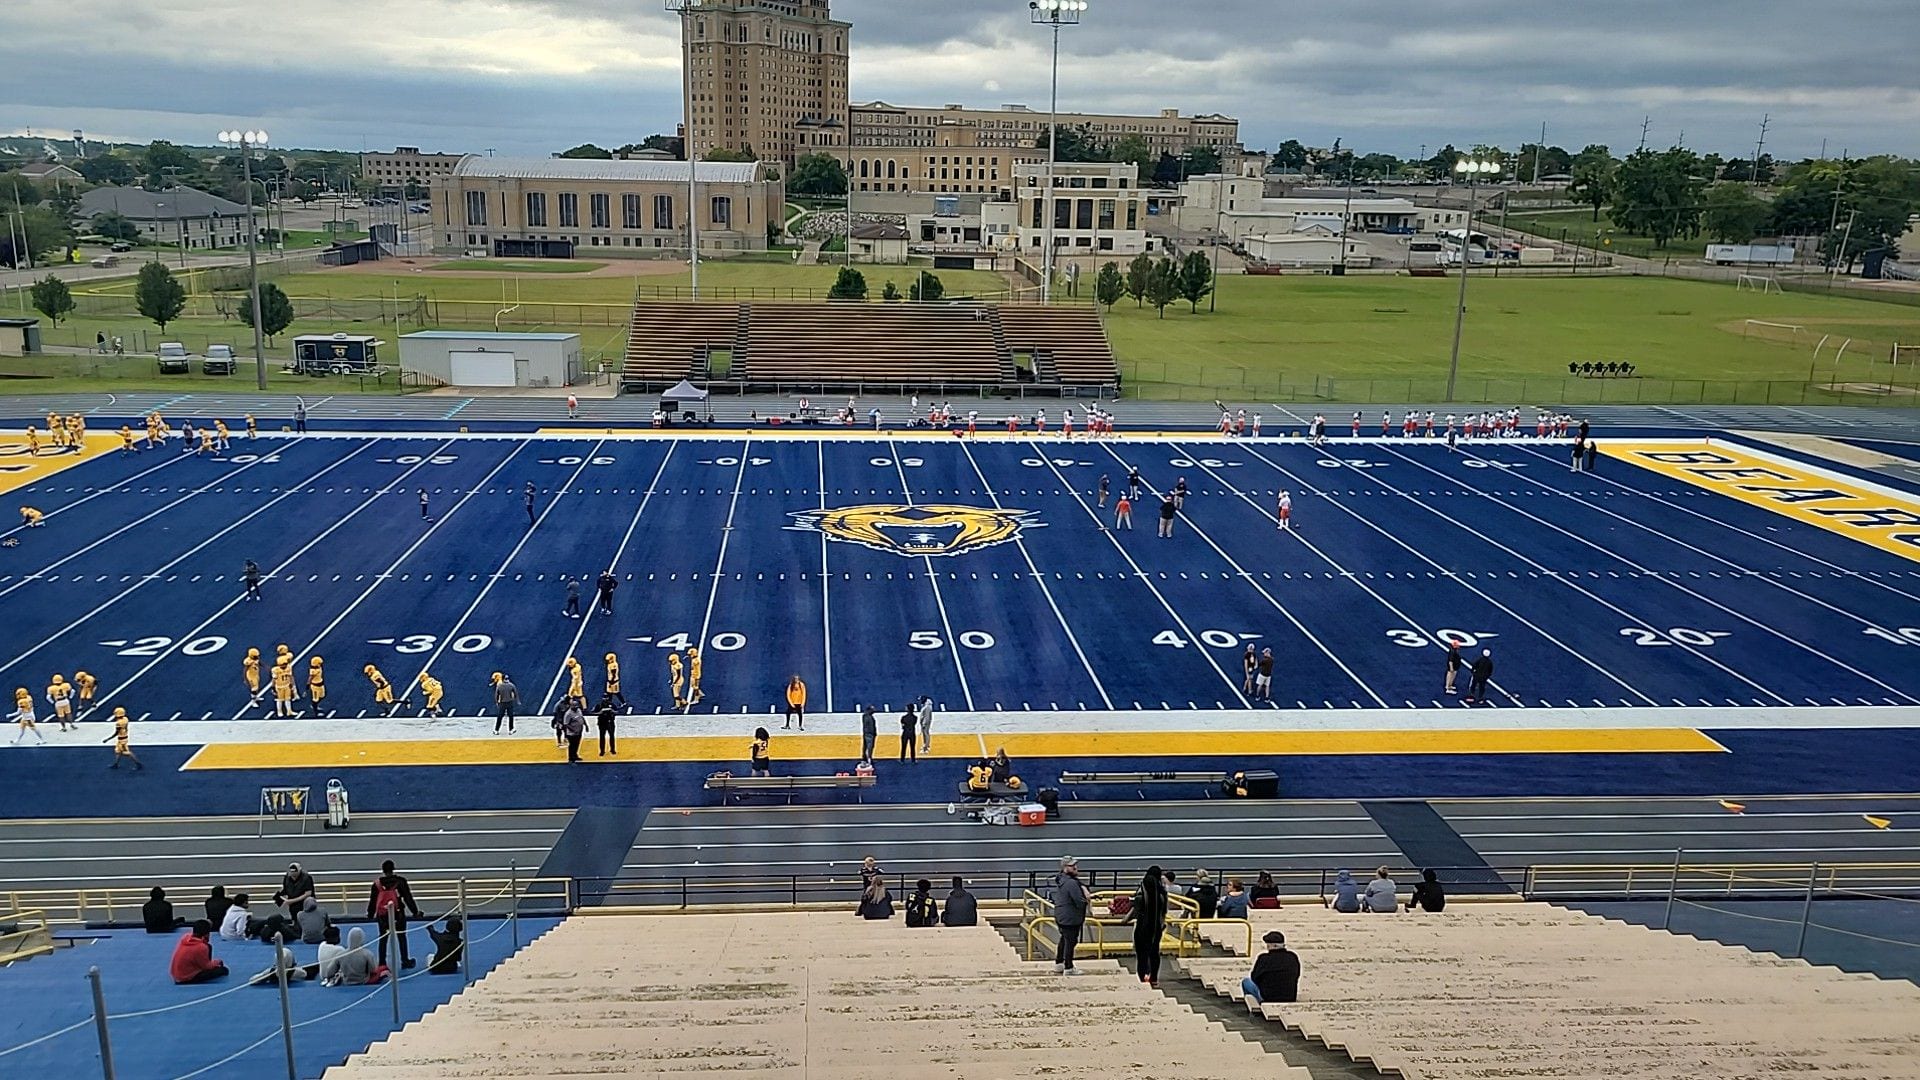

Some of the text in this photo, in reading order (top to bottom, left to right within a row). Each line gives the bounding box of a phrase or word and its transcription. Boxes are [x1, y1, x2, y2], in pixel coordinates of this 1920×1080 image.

[1634, 450, 1920, 548] BEAR
[908, 631, 995, 649] 50
[980, 773, 987, 783] 6
